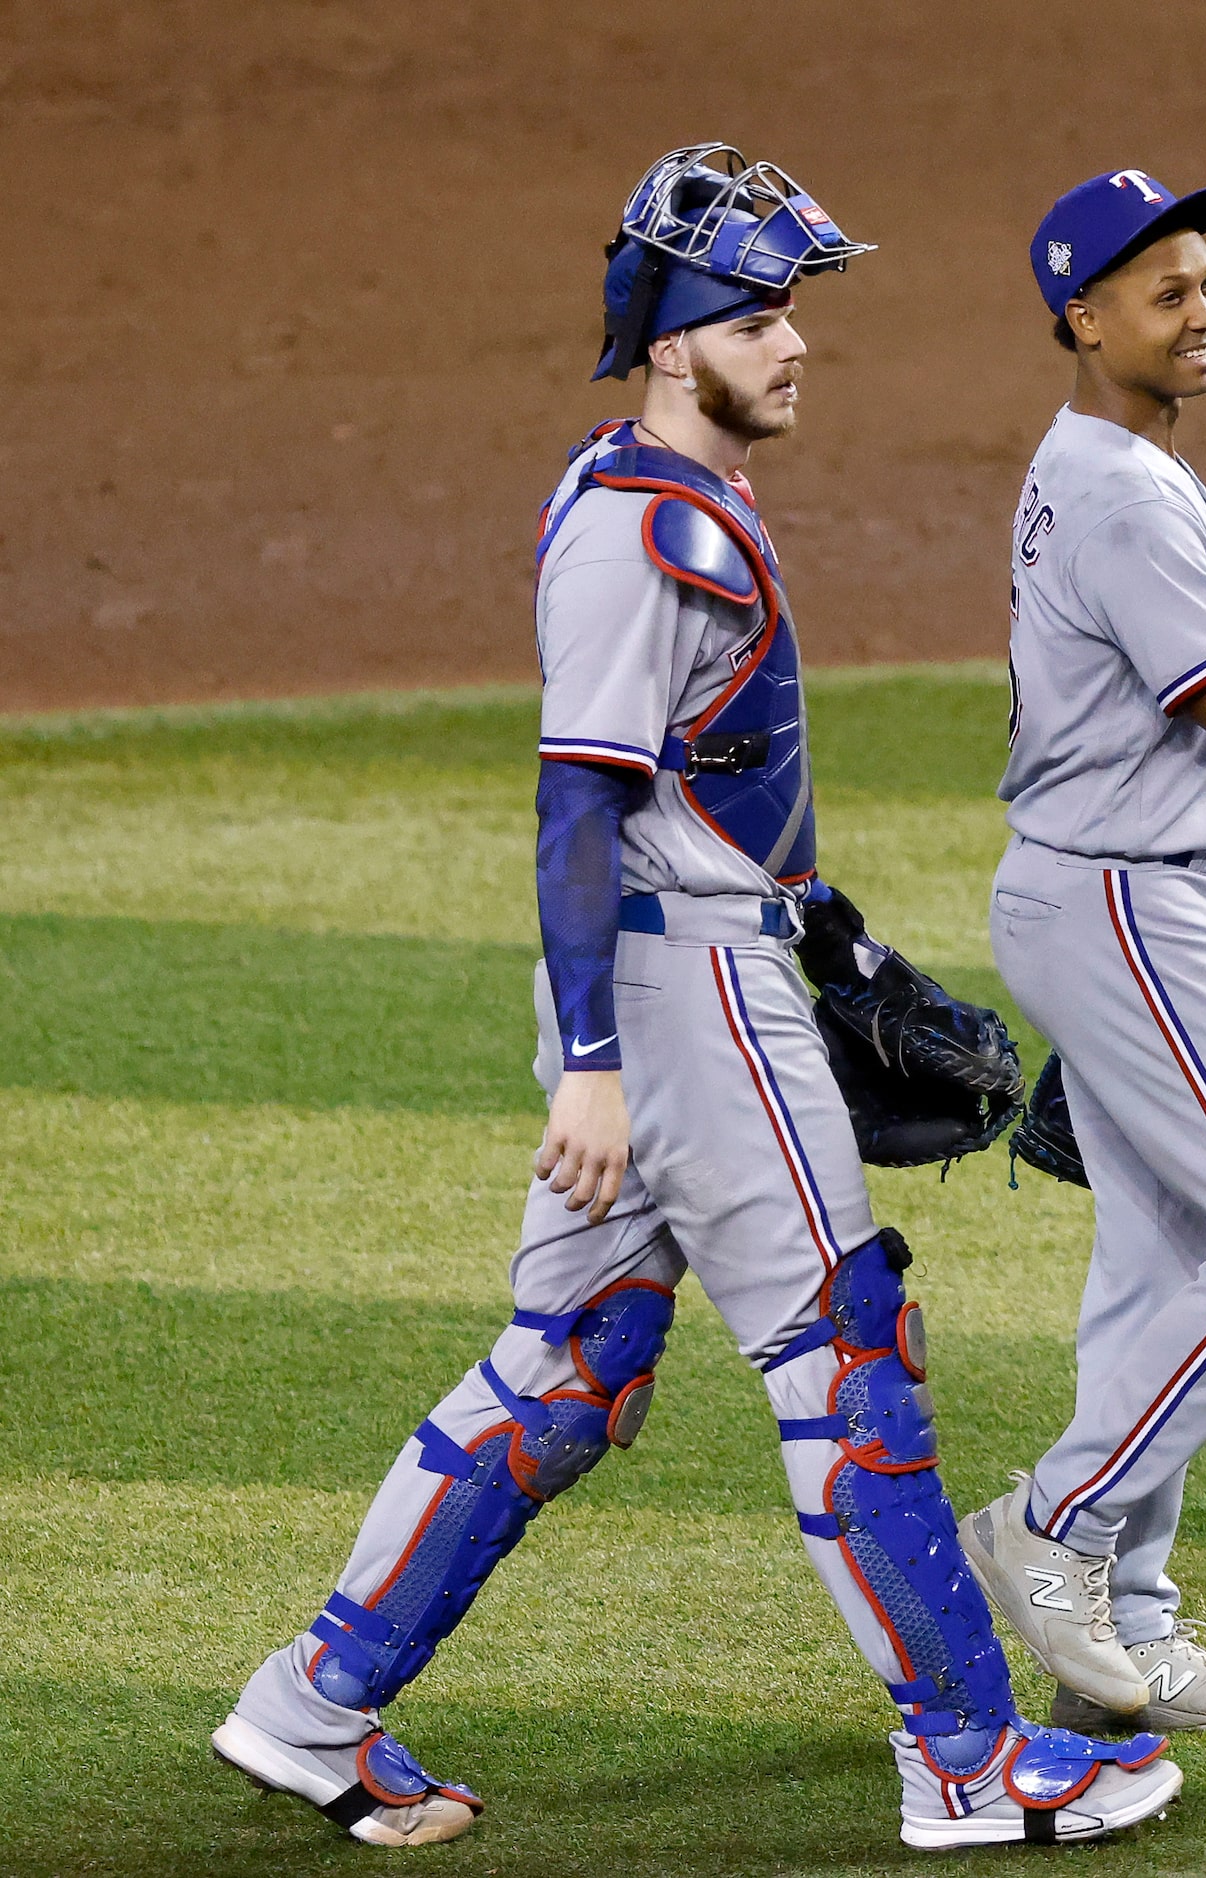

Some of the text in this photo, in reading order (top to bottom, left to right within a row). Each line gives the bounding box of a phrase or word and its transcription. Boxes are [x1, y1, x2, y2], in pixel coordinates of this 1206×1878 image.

[1109, 169, 1163, 204] T
[1023, 1564, 1075, 1613] N
[1144, 1660, 1198, 1704] N
